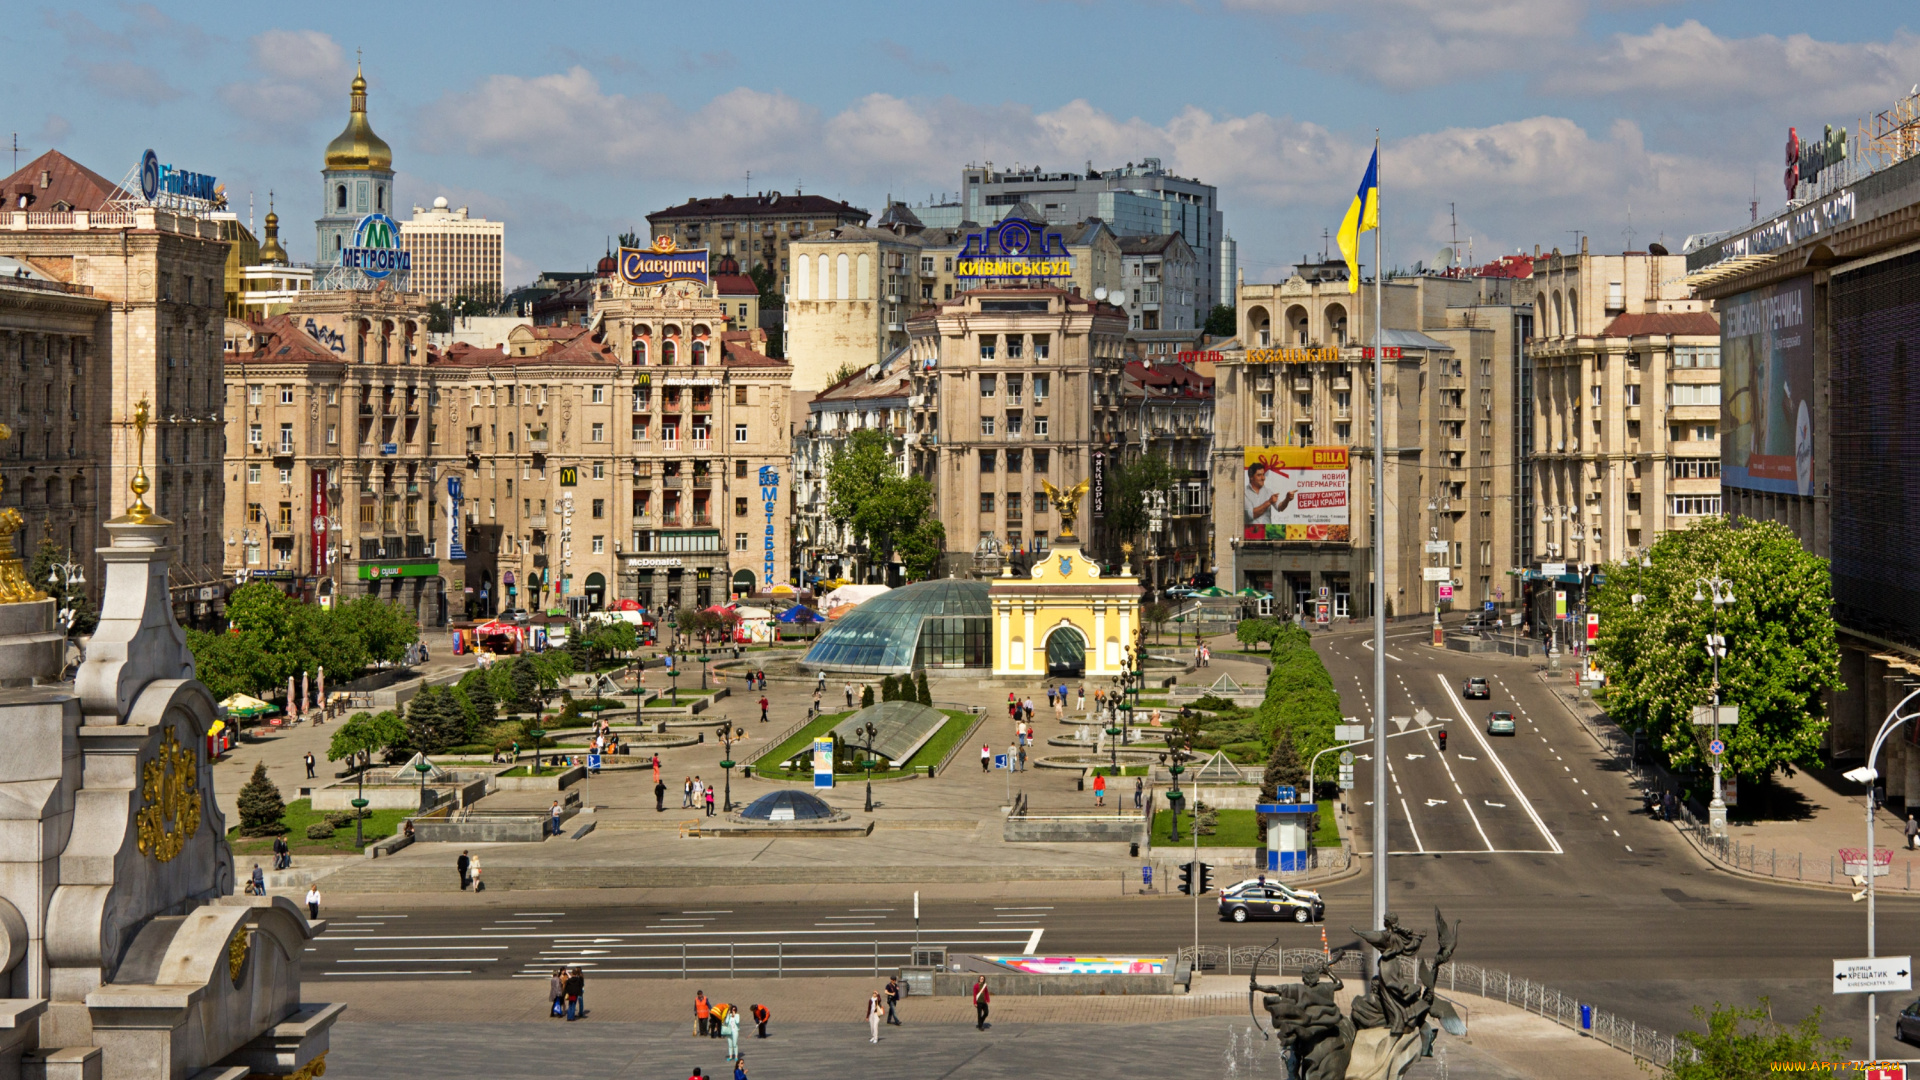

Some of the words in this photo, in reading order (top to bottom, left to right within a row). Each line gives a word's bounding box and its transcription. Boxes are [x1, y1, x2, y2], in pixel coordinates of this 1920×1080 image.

[159, 164, 216, 201] FinBANK
[341, 248, 411, 270] МЕТРОБУД
[624, 253, 706, 278] Славутич
[959, 260, 1070, 276] КИЇВМІСЬКБУД
[1762, 289, 1803, 332] ТУРЕЧЧИНА
[1178, 351, 1224, 363] ГОТЕЛЬ
[1247, 346, 1338, 365] КОЗАЦЬКИЙ
[666, 377, 719, 386] McDonald's
[1315, 452, 1344, 463] BILLA
[1322, 472, 1346, 480] НОВИЙ
[1095, 459, 1103, 511] ЯКИТОРИЯ
[1299, 499, 1319, 508] СЕРЦІ
[1320, 497, 1345, 506] КРАЇНИ
[628, 558, 682, 567] McDonald's
[1848, 971, 1888, 980] ХРЕЩАТИК
